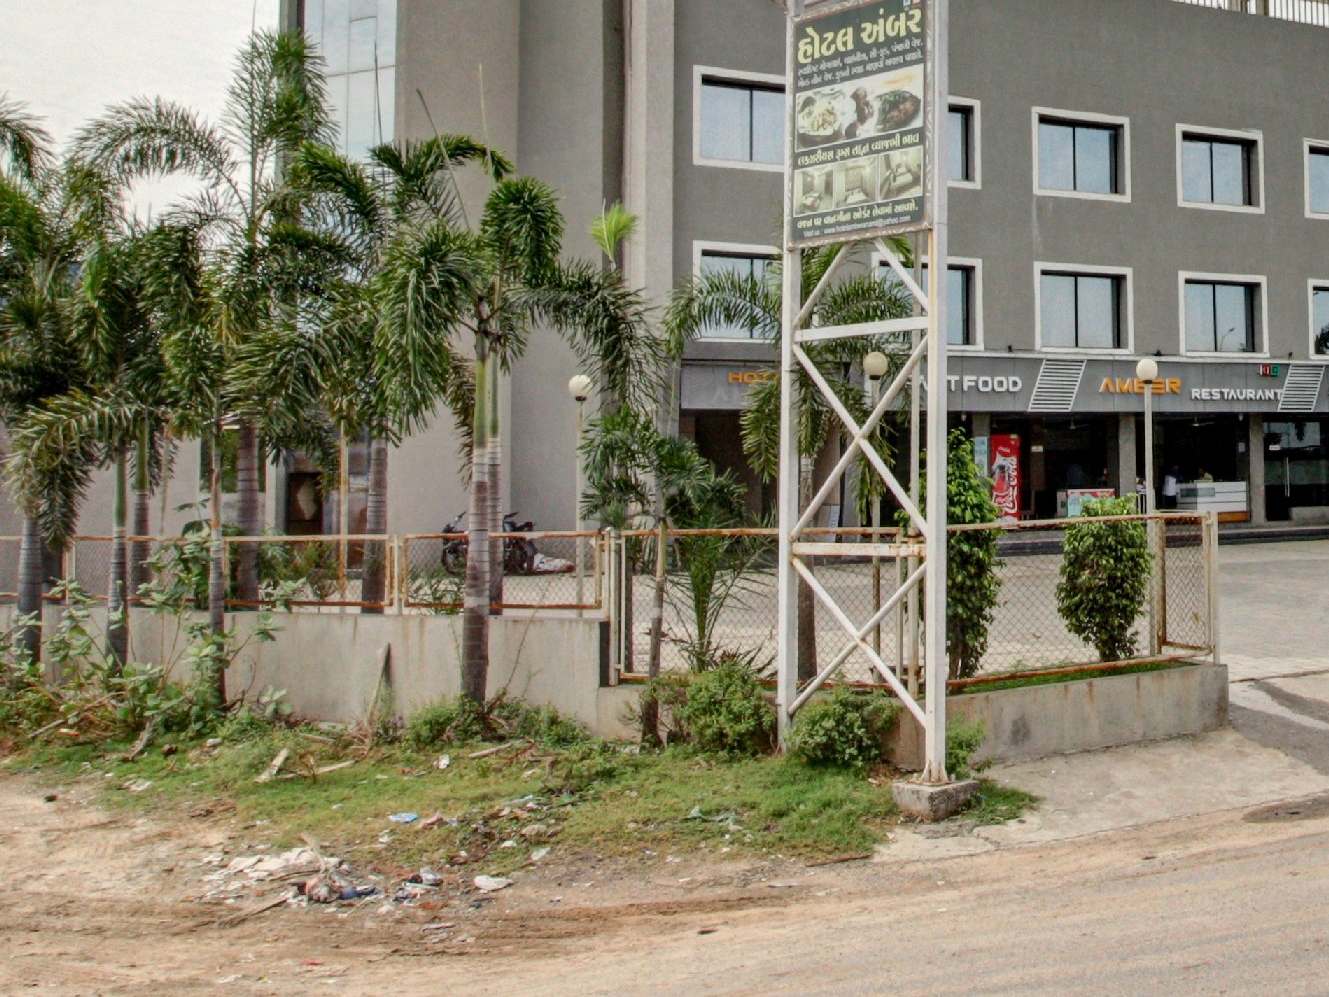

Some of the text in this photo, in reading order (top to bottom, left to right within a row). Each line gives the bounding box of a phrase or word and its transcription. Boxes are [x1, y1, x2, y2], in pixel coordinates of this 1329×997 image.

[798, 26, 854, 64] હોટલ
[860, 8, 922, 44] અંબર
[962, 376, 1022, 392] FOOD
[1191, 388, 1284, 401] RESTAURANT
